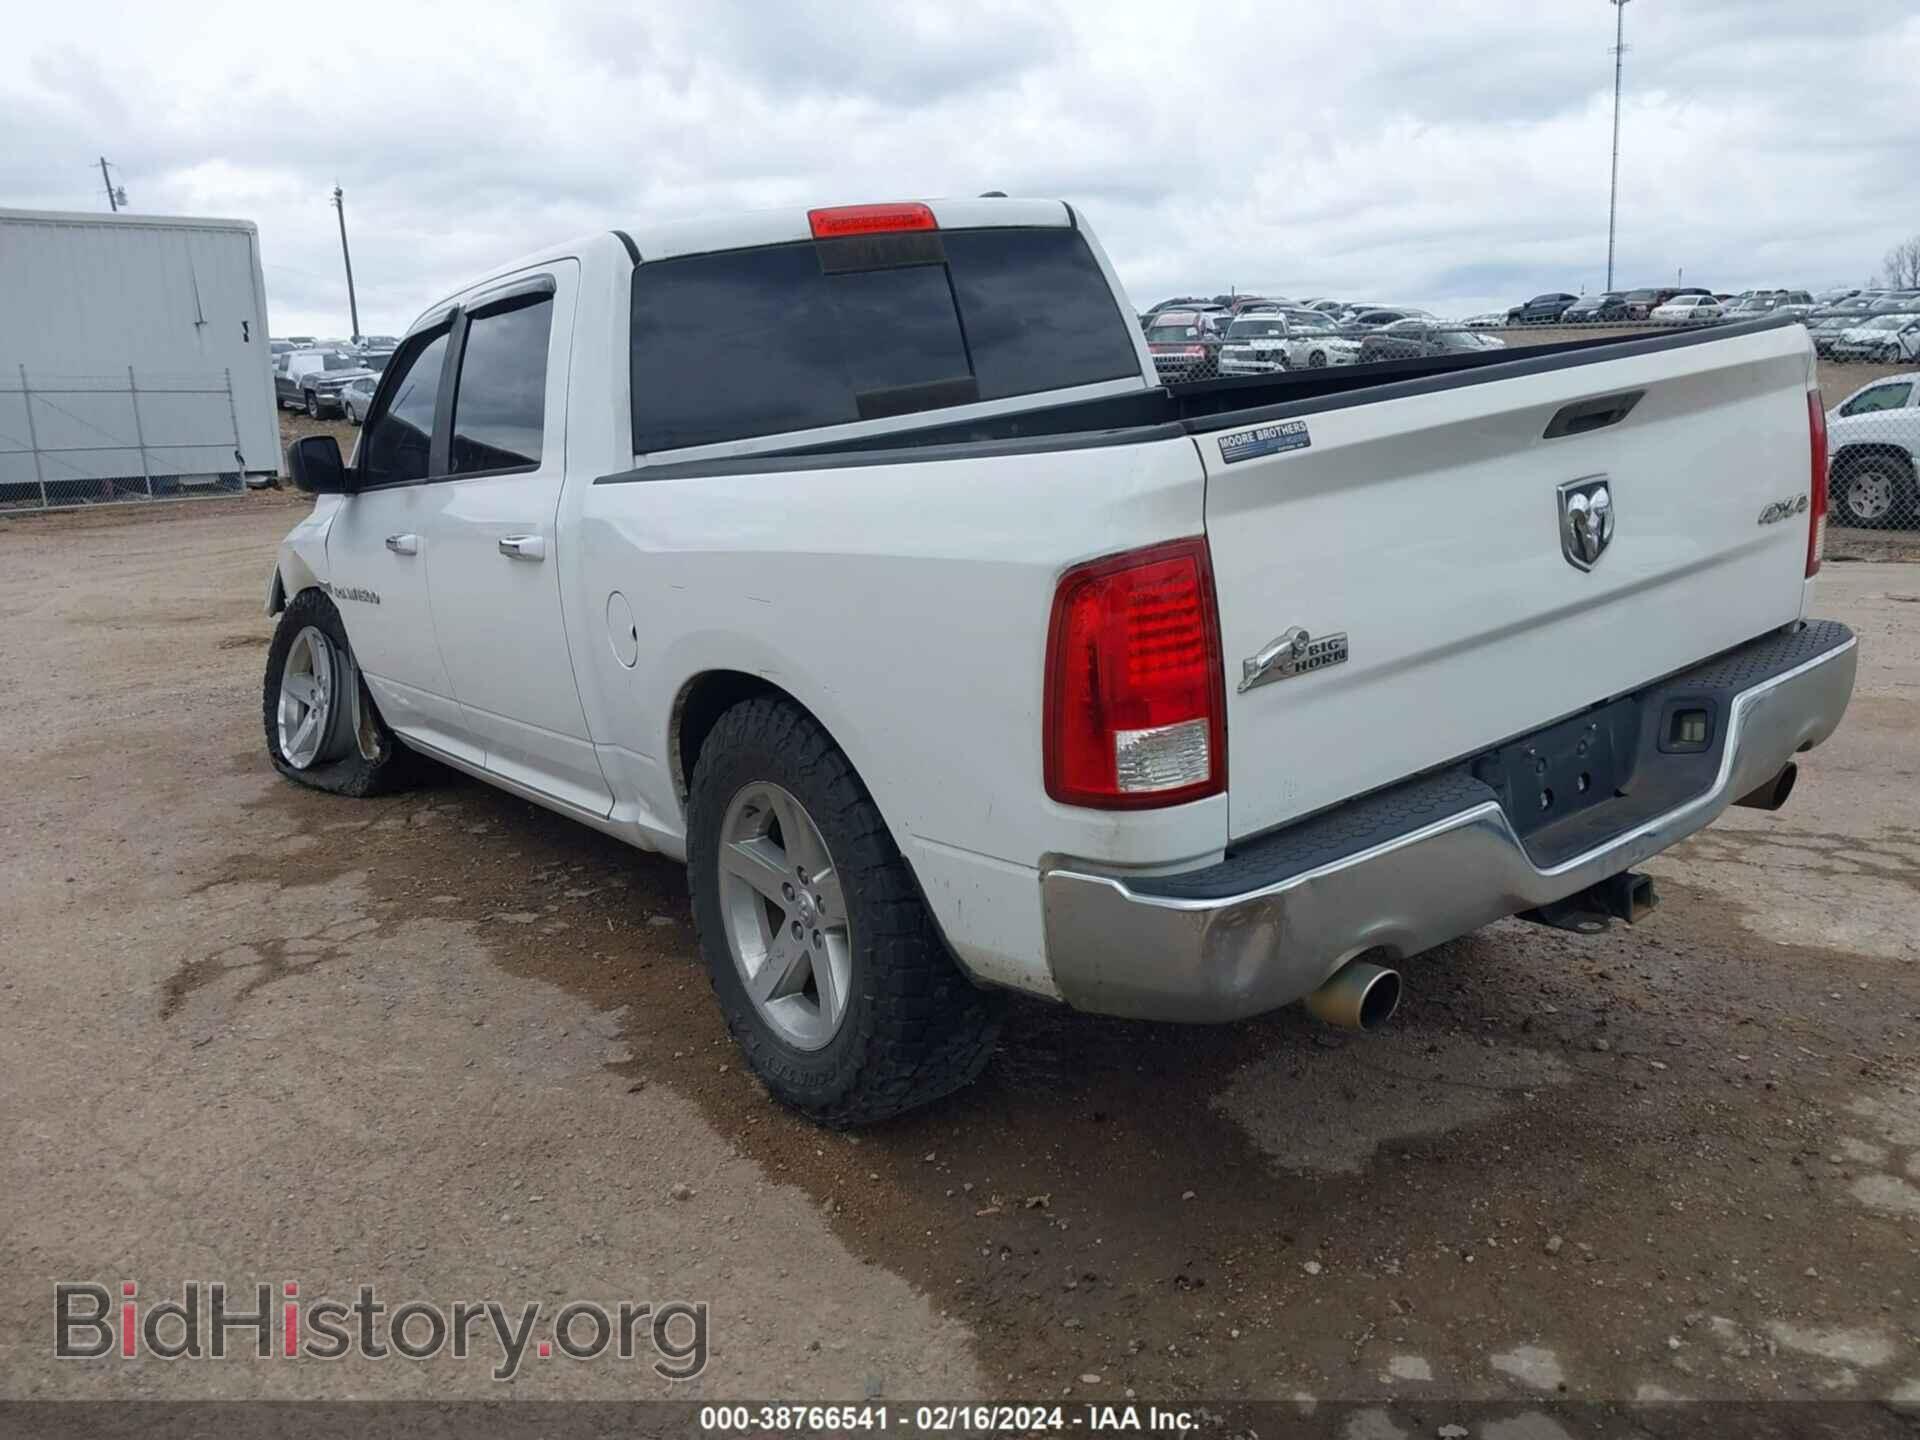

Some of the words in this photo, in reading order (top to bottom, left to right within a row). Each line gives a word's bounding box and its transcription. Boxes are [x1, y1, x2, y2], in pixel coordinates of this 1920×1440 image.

[1219, 431, 1257, 448] MOORE
[1255, 422, 1307, 441] BROTHERS
[1308, 638, 1341, 656] BIG
[1295, 648, 1346, 672] HORN
